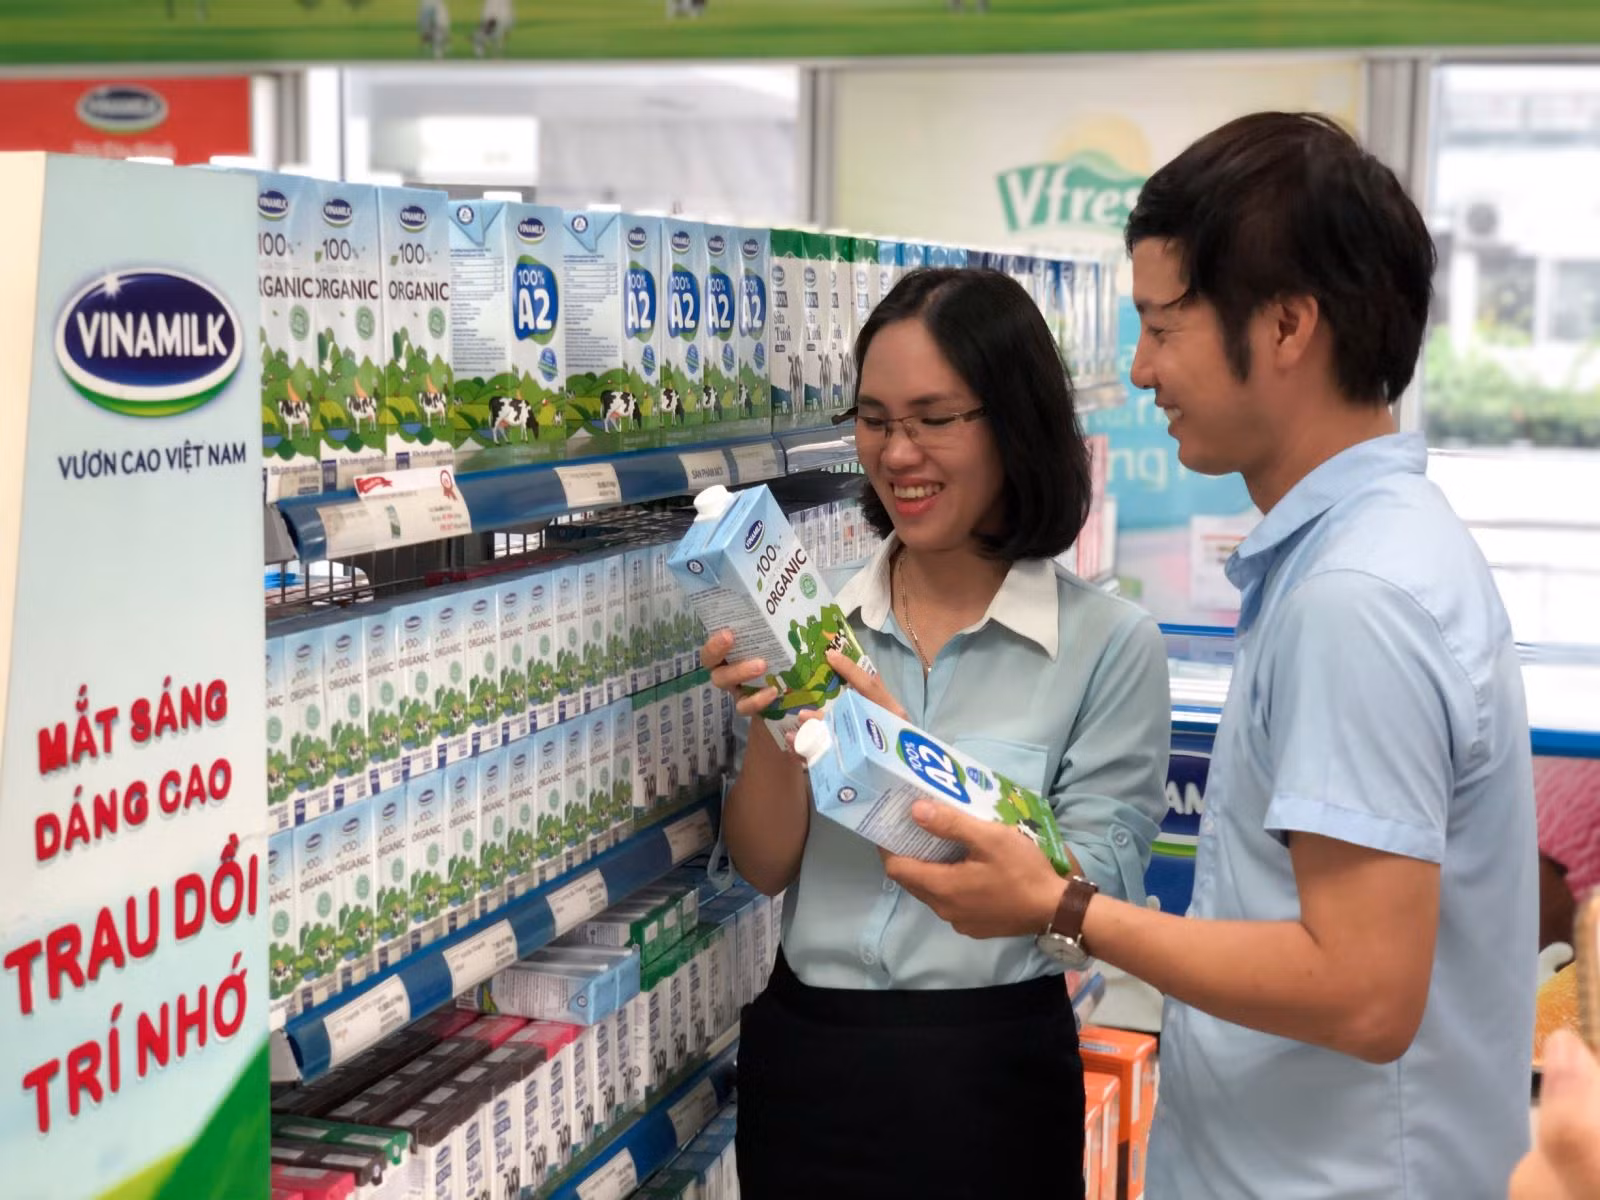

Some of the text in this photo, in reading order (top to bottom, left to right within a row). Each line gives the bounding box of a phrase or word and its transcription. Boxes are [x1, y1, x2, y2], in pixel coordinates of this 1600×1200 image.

[1005, 163, 1142, 226] Vfres
[388, 281, 449, 301] ORGANIC
[518, 287, 552, 330] A2
[628, 290, 651, 329] A2
[671, 292, 696, 329] A2
[708, 293, 731, 329] A2
[742, 294, 763, 329] A2
[76, 311, 228, 358] VINAMILK
[58, 439, 247, 481] VƯƠN CAO VIỆT NAM
[766, 548, 807, 615] ORGANIC
[398, 652, 430, 668] ORGANIC
[37, 675, 228, 776] MẮT SÁNG
[918, 744, 962, 796] A2
[34, 757, 232, 863] DÁNG CAO
[4, 832, 259, 1016] TRAU DỒI
[22, 951, 248, 1135] TRÍ NHỚ
